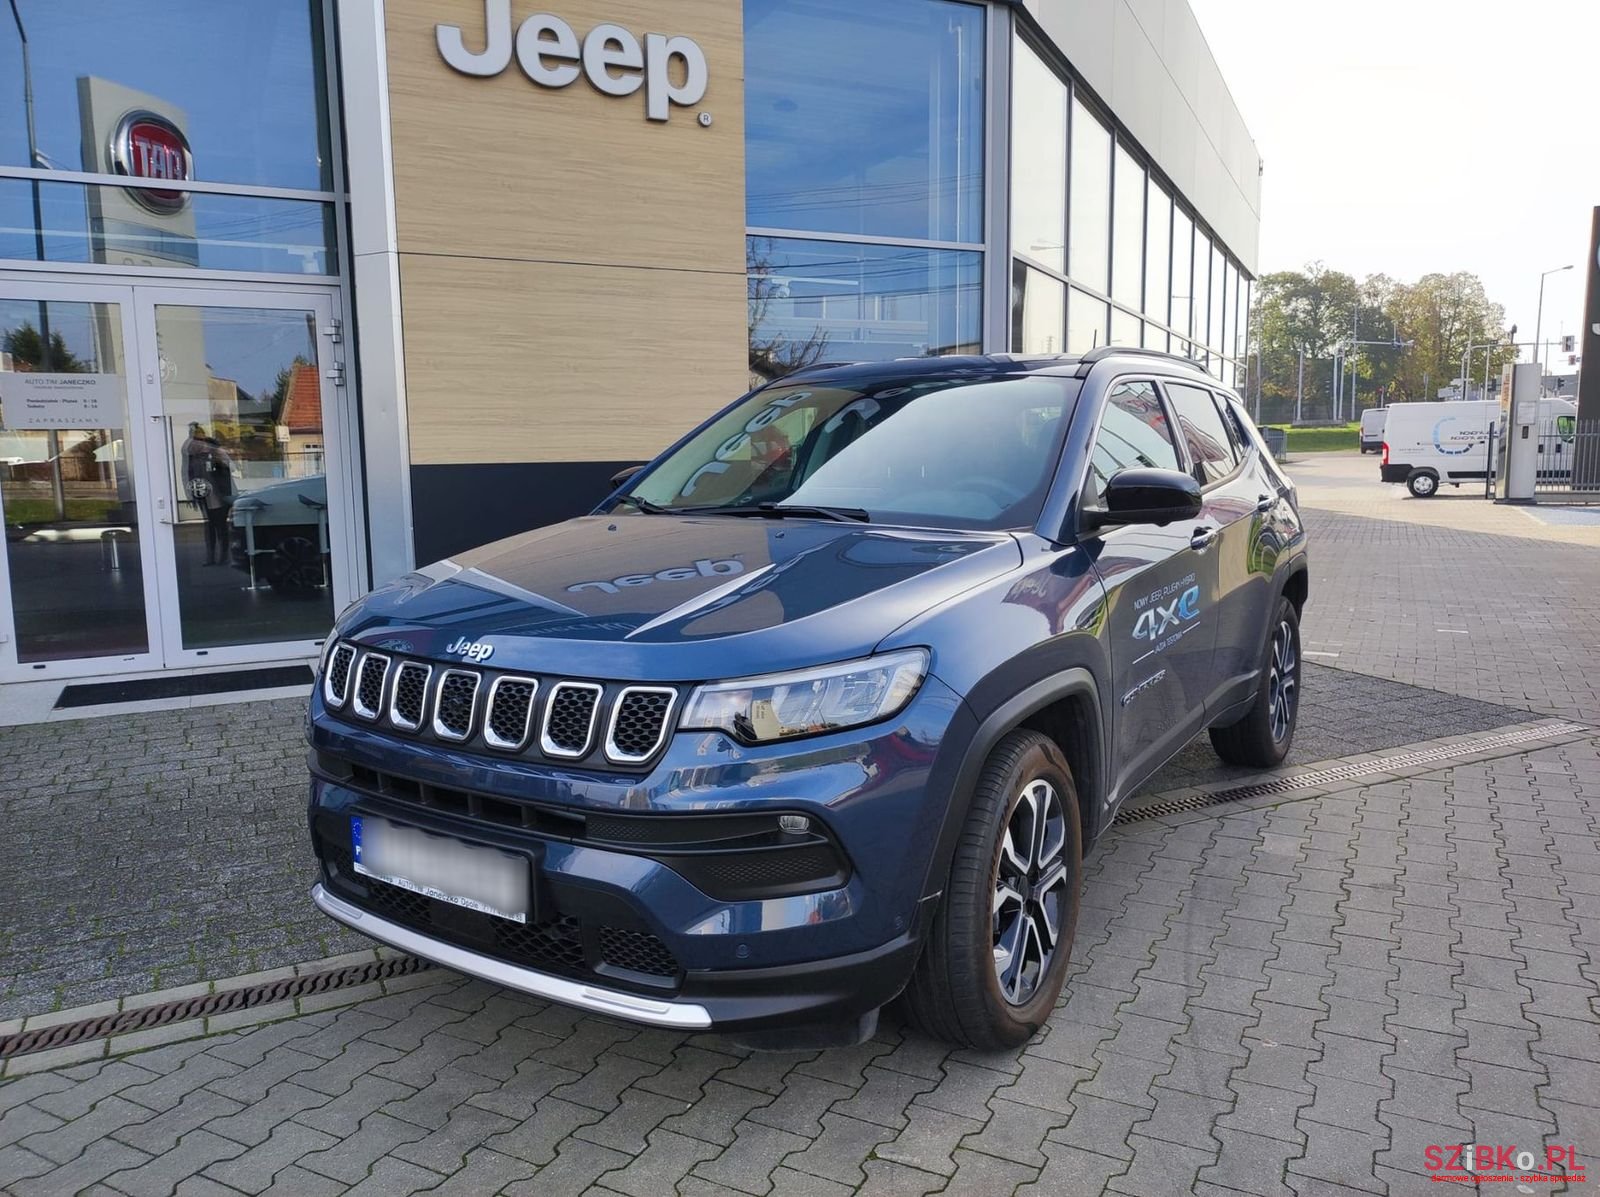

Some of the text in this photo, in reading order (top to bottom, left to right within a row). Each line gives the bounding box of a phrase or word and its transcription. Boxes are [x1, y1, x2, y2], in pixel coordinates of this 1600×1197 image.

[435, 0, 709, 123] Jeep
[446, 636, 495, 662] Jeep
[425, 887, 459, 904] Janeczko
